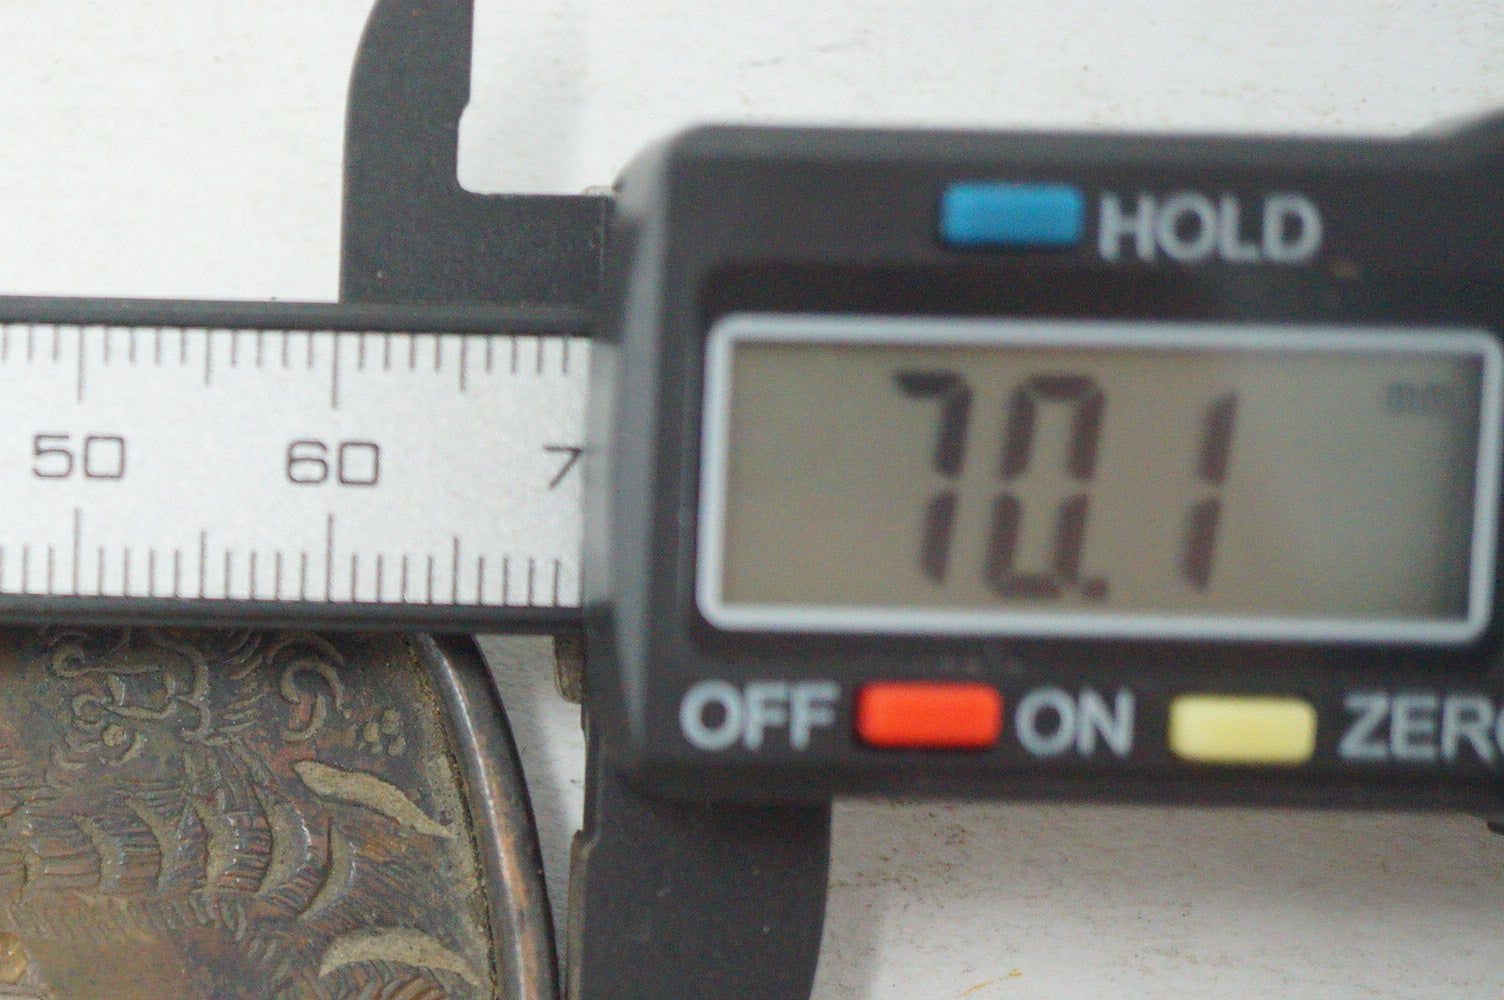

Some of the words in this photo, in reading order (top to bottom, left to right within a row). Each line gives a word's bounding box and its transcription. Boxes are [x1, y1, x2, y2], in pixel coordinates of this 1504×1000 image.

[1096, 190, 1324, 264] HOLD
[30, 431, 128, 482] 50
[284, 438, 382, 488] 60
[541, 443, 584, 491] 7
[889, 365, 1239, 604] 70.1
[678, 680, 839, 752] OFF
[1013, 687, 1136, 757] ON
[1337, 690, 1504, 763] ZER
